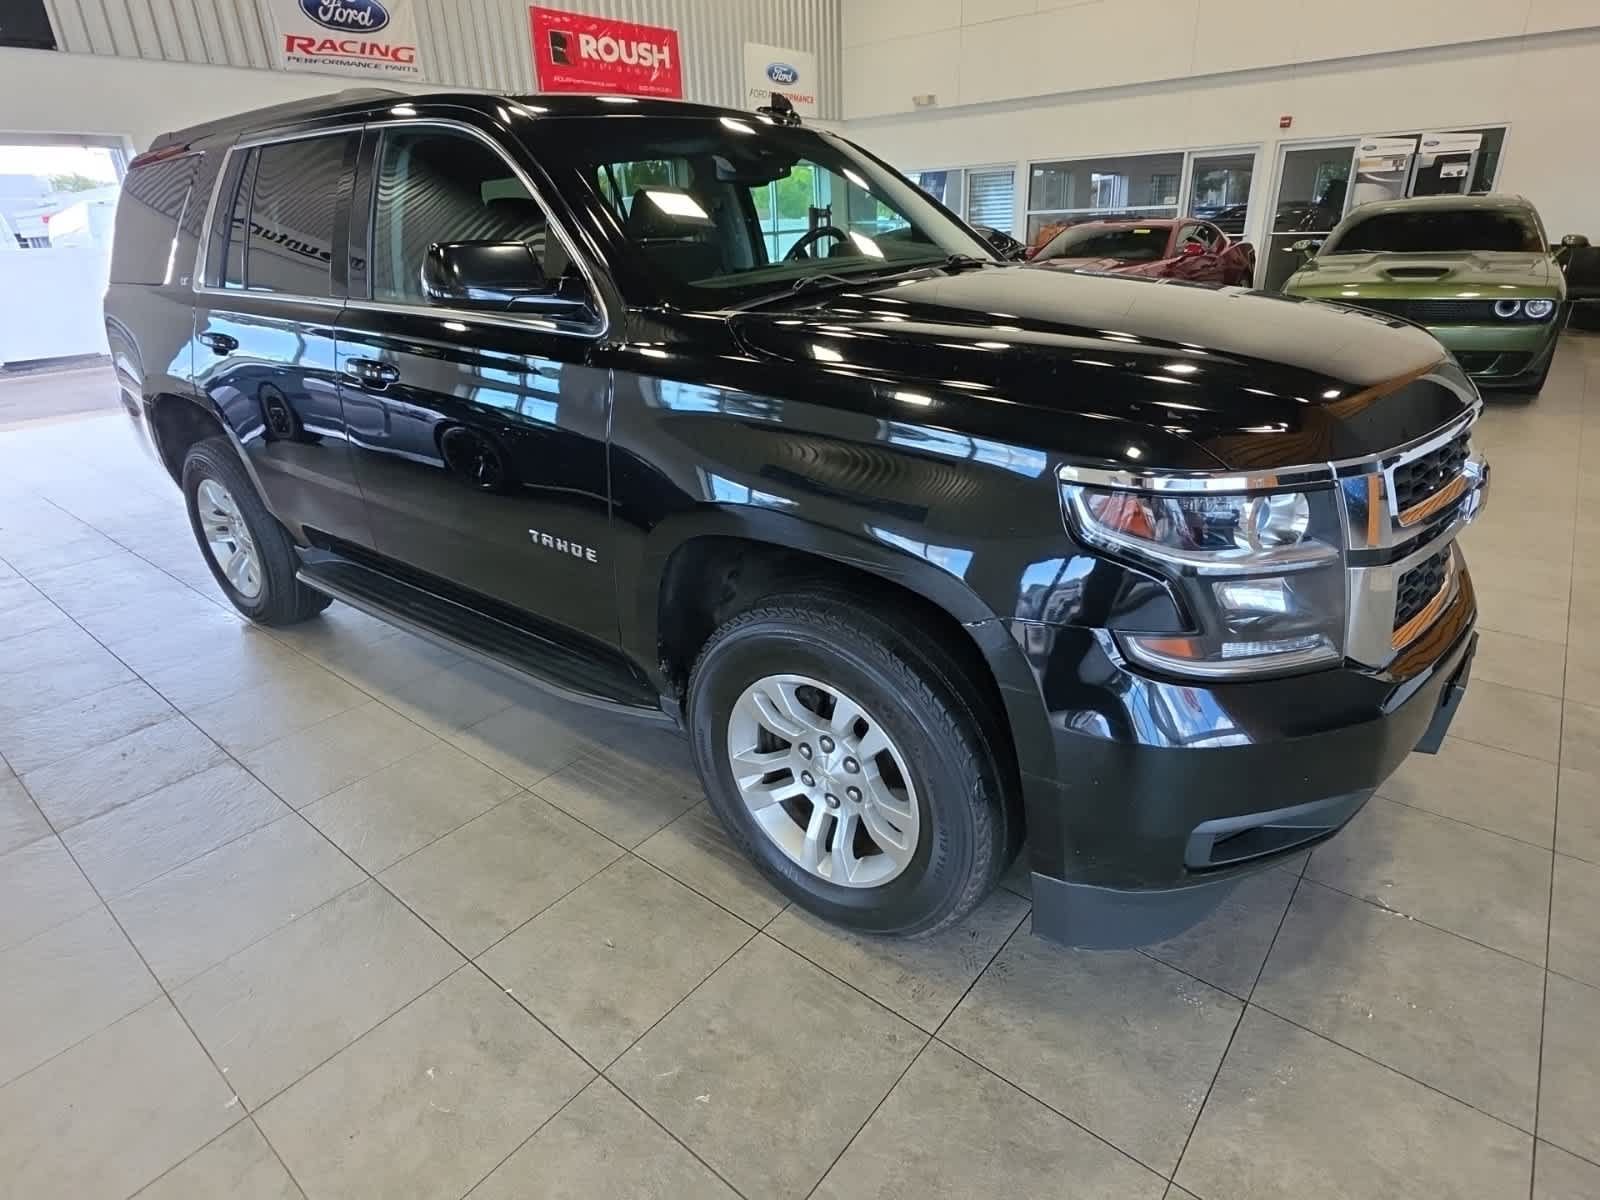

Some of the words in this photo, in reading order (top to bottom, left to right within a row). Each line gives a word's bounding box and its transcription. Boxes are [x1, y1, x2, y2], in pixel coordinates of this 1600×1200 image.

[318, 0, 374, 27] Ford
[284, 34, 416, 64] RACING
[578, 33, 671, 69] ROUSH
[287, 55, 381, 70] PERFORMANCE
[384, 62, 419, 73] PARTS
[772, 66, 793, 82] Ford
[768, 90, 815, 104] PRMANCE
[528, 529, 598, 563] TAHOE
